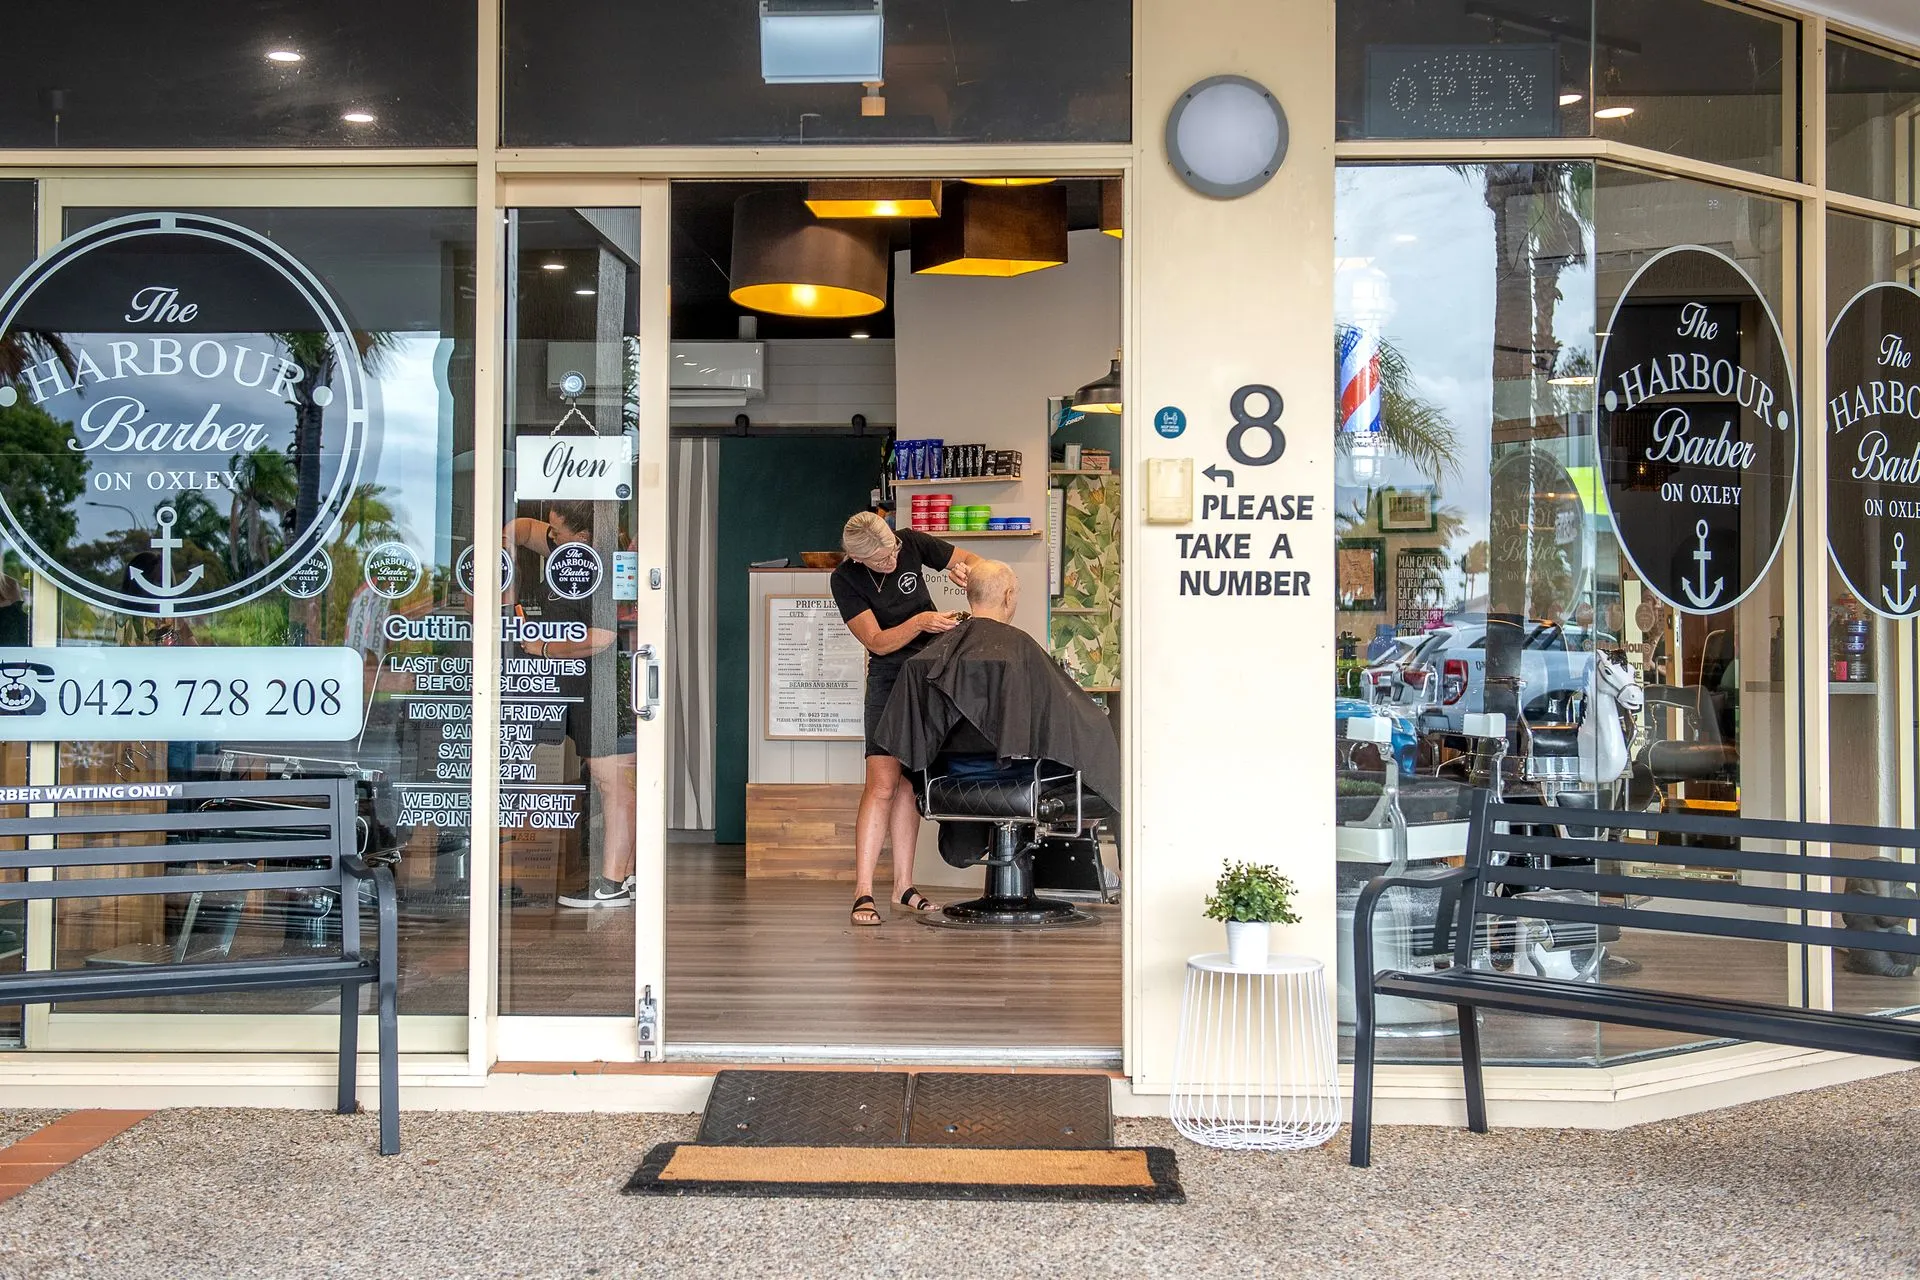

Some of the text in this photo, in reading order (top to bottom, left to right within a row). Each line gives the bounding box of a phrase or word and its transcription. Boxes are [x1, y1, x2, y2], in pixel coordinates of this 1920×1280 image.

[1389, 75, 1536, 111] OPEN
[124, 286, 198, 323] The
[1677, 302, 1718, 340] The
[1877, 334, 1912, 368] The
[21, 338, 305, 405] HARBOUR
[1619, 353, 1774, 427] HARBOUR
[1829, 380, 1920, 434] HARBO
[67, 395, 269, 451] Barber
[1226, 384, 1286, 466] 8
[1645, 407, 1756, 469] Barber
[543, 441, 614, 493] Open
[1852, 430, 1920, 484] Barb
[94, 471, 241, 491] ON OXLEY
[1661, 482, 1741, 505] ON OXLEY
[1202, 495, 1314, 520] PLEASE
[1864, 498, 1883, 517] ON
[384, 549, 400, 557] The
[566, 549, 583, 558] The
[1176, 533, 1293, 559] TAKE A
[373, 557, 412, 569] HARBOUR
[378, 566, 408, 576] Barber
[554, 559, 594, 570] HARBOUR
[559, 567, 590, 576] Barber
[1398, 556, 1414, 568] MAN
[1417, 556, 1435, 568] CAVE
[925, 574, 948, 583] Don't
[1180, 570, 1311, 596] NUMBER
[1398, 588, 1411, 599] EAT
[384, 614, 588, 642] Cuttin Hours
[390, 657, 438, 673] LAST
[441, 657, 473, 673] CUT
[506, 659, 586, 676] MINUTES
[58, 679, 341, 716] 0423 728 208
[409, 704, 567, 720] MONDA FRIDAY
[438, 743, 536, 760] SATDAY
[45, 786, 124, 799] WAITING
[128, 784, 177, 798] ONLY
[519, 794, 575, 811] NIGHT
[531, 813, 580, 829] ONLY
